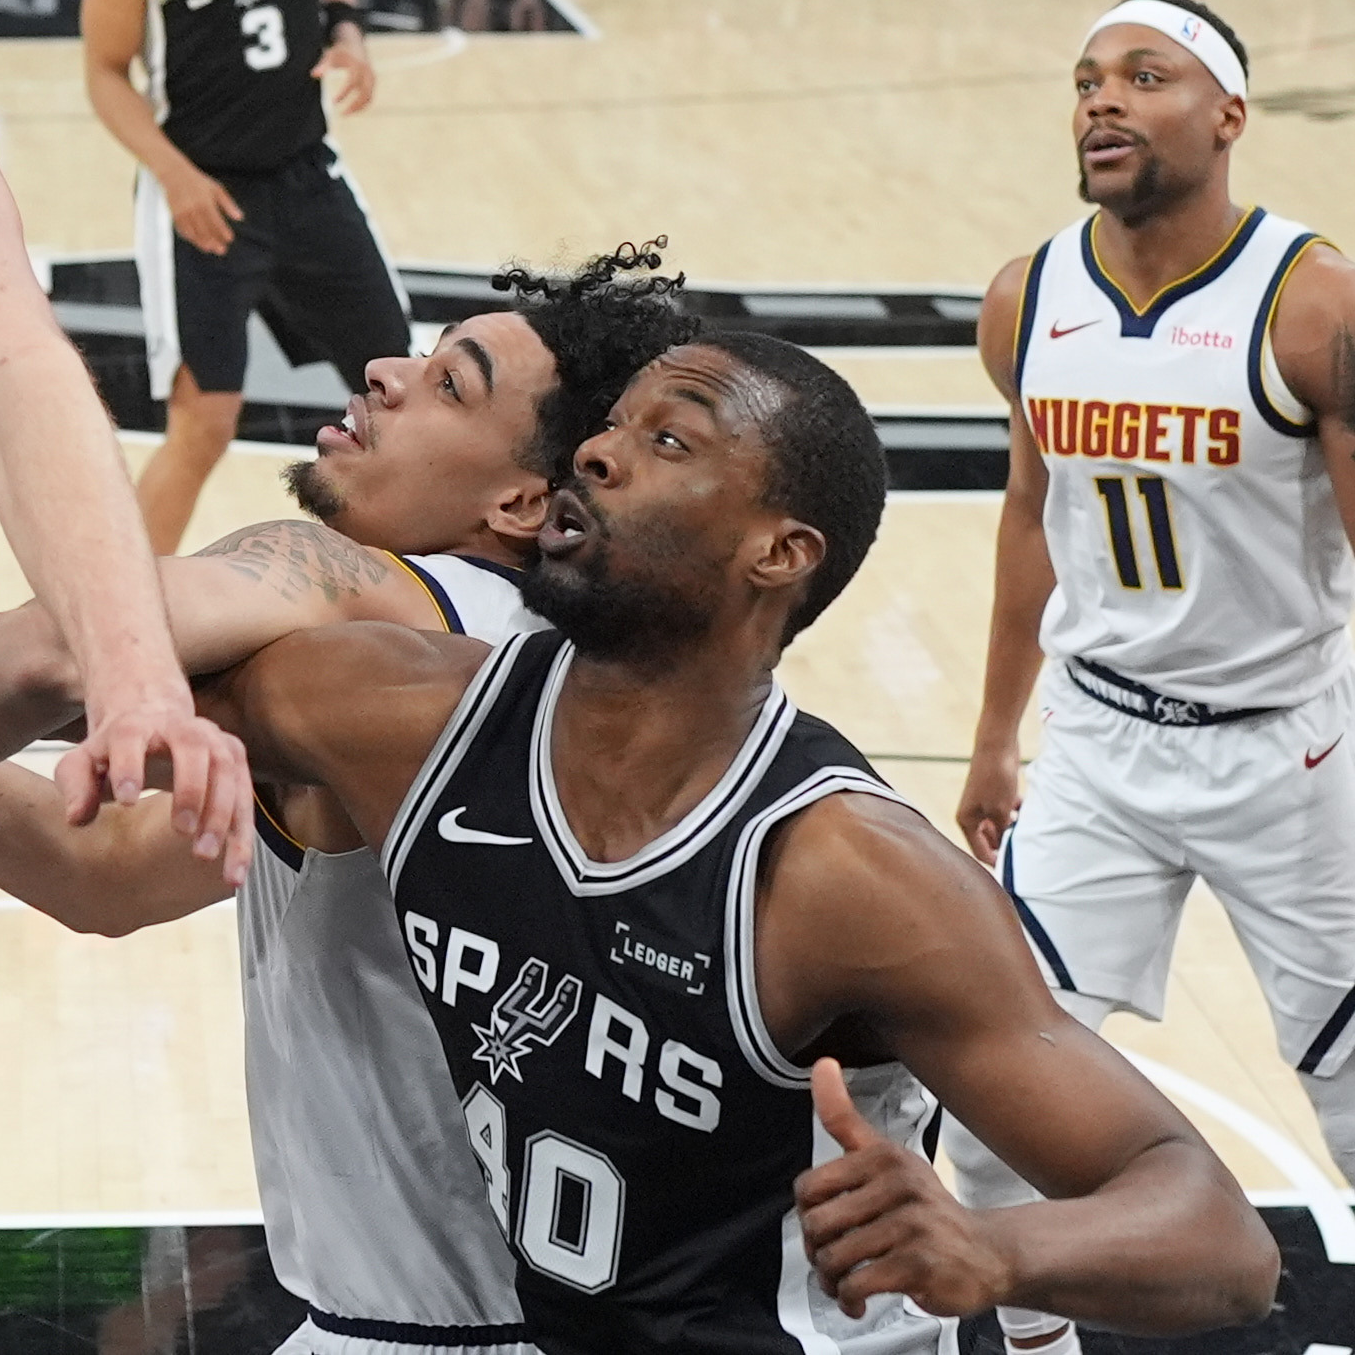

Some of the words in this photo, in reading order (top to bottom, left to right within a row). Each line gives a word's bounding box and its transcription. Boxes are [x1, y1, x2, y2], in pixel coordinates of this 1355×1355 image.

[240, 4, 288, 72] 3
[1171, 326, 1233, 350] ibotta
[1026, 396, 1241, 467] NUGGETS
[1092, 475, 1185, 591] 11
[622, 937, 694, 982] LEDGER
[404, 910, 723, 1133] SPURS
[461, 1080, 627, 1296] 40
